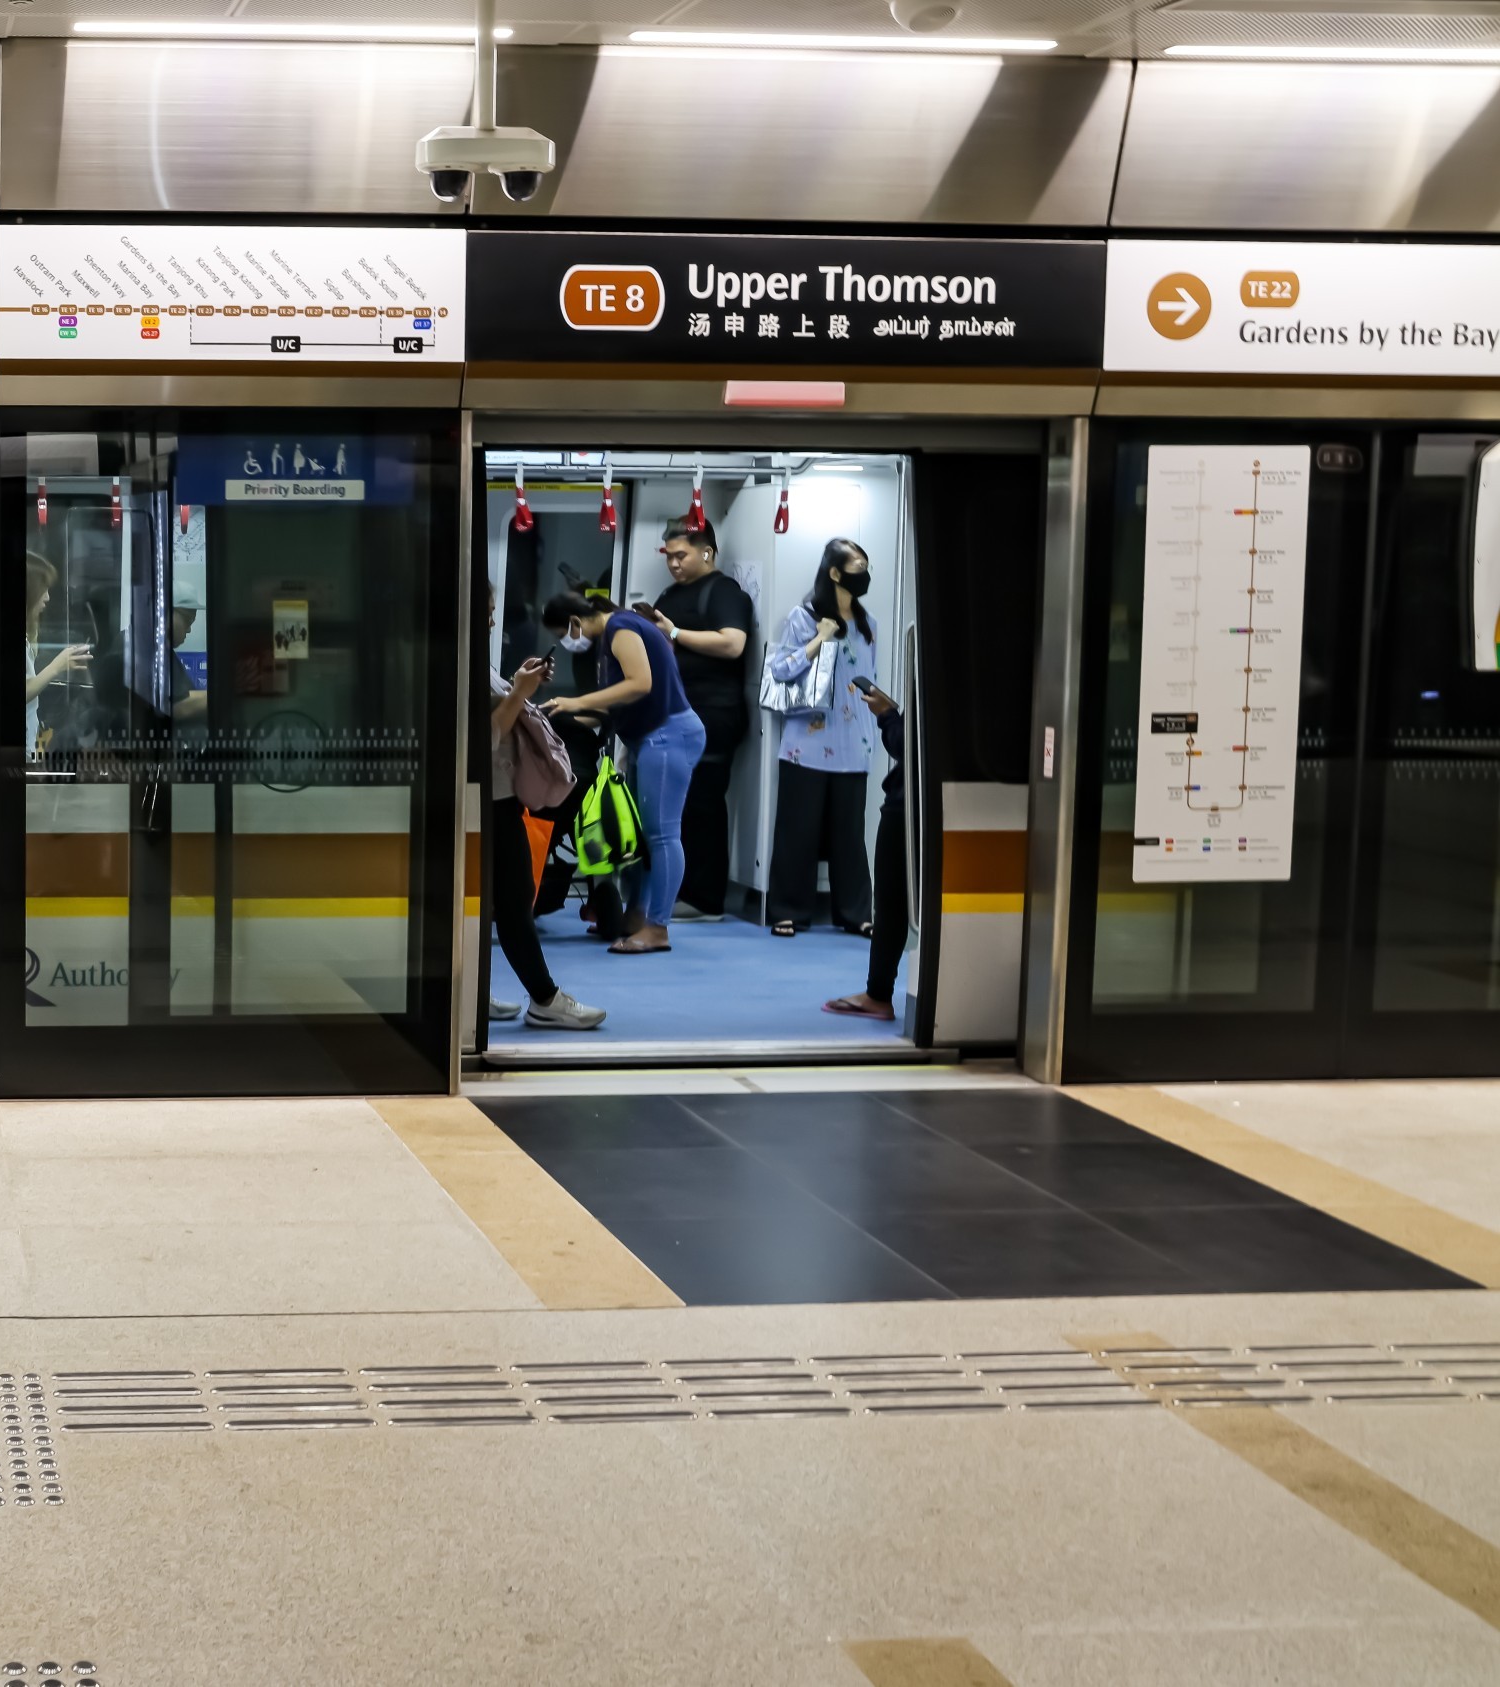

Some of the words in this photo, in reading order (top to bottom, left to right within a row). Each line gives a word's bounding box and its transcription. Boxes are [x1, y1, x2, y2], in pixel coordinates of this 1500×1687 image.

[13, 265, 44, 298] Havelock
[30, 254, 56, 282] Outram
[55, 279, 73, 298] Park
[71, 269, 101, 298] Maxwell
[84, 254, 112, 284] Shenton
[111, 281, 127, 299] Way
[117, 260, 141, 286] Marina
[140, 284, 155, 299] Bay
[120, 235, 148, 265] Gardens
[146, 262, 157, 274] by
[155, 271, 168, 285] the
[167, 284, 182, 299] Bay
[167, 255, 195, 286] Tanjong
[193, 282, 209, 299] Rhu
[195, 257, 221, 284] Katong
[219, 281, 236, 299] Park
[212, 245, 240, 276] Tanjong
[238, 273, 264, 300] Katong
[244, 250, 268, 277] Marine
[266, 274, 290, 300] Parade
[269, 249, 293, 275] Marine
[292, 273, 318, 300] Terrace
[579, 284, 616, 312] TE
[625, 284, 645, 313] 8
[688, 264, 808, 308] Upper
[818, 264, 997, 305] Thomson
[1248, 280, 1268, 299] TE
[1270, 280, 1292, 299] 22
[688, 312, 851, 339] 汤申路上段
[872, 314, 931, 340] அப்பர்
[938, 316, 1017, 341] தாம்சன்
[1239, 320, 1349, 345] Gardens
[1359, 321, 1389, 350] by
[1400, 322, 1443, 346] the
[1453, 323, 1499, 351] Bay
[276, 339, 297, 351] U/C
[398, 340, 419, 352] U/C
[244, 483, 289, 498] Priority
[292, 483, 346, 498] Boarding
